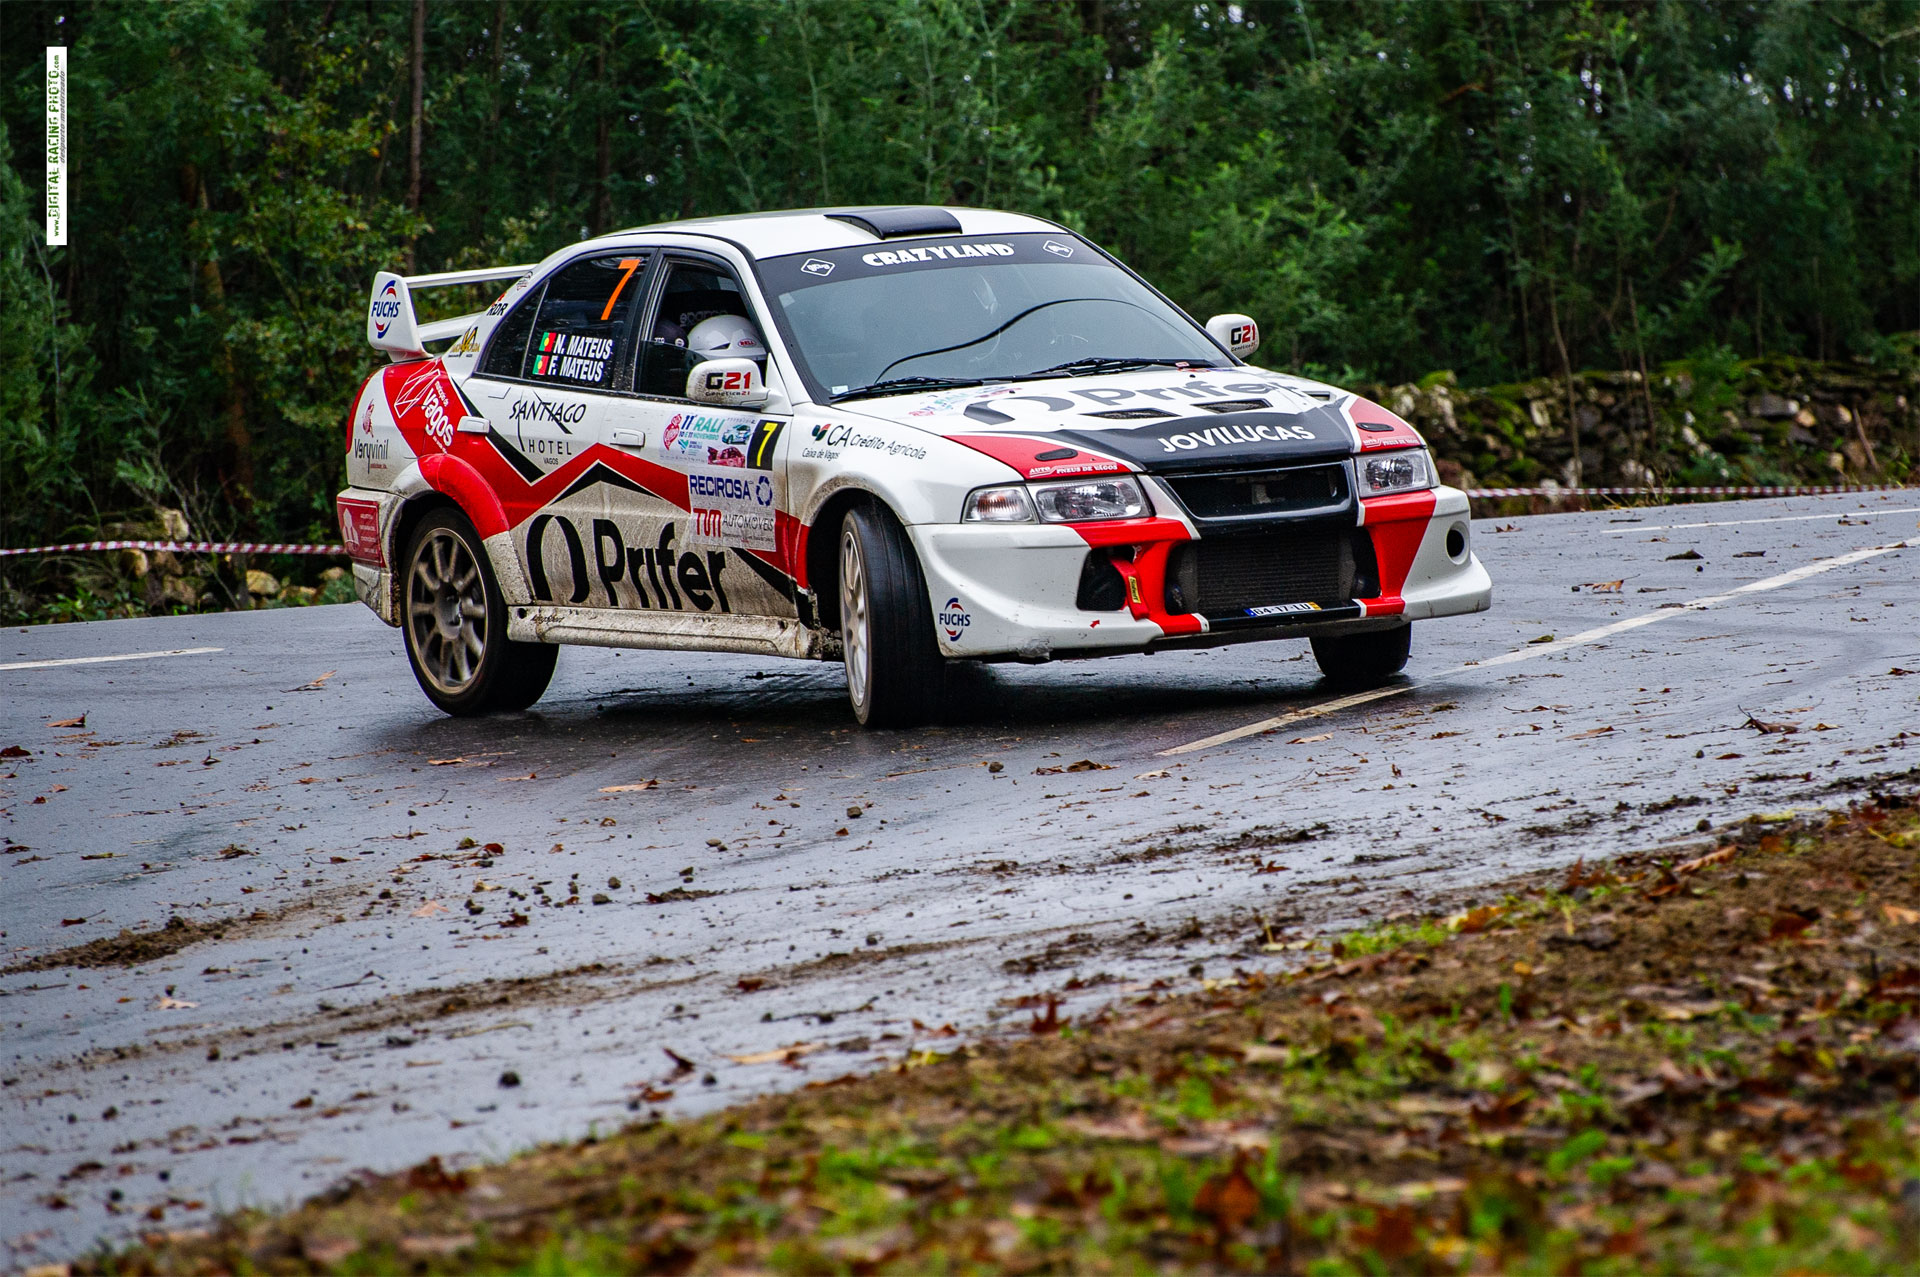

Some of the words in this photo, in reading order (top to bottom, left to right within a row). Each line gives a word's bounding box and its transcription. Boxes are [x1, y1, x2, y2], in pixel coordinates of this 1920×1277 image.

[862, 243, 1015, 267] CRAZYLAND
[600, 259, 641, 321] 7
[371, 301, 401, 318] FUCHS
[553, 333, 567, 355] N.
[566, 335, 613, 360] MATEUS
[1230, 323, 1256, 346] G21
[547, 355, 560, 376] F.
[559, 356, 604, 382] MATEUS
[705, 371, 752, 390] G21
[509, 400, 587, 425] SANTIAGO
[693, 417, 726, 433] RALI
[528, 439, 572, 456] HOTEL
[756, 422, 778, 467] 7
[827, 425, 853, 447] CA
[850, 434, 885, 450] Crédito
[884, 440, 927, 460] Agrícola
[1157, 425, 1316, 453] JOVILUCAS
[543, 457, 559, 466] VAGOS
[1028, 466, 1051, 474] AUTO
[689, 474, 752, 501] RECIROSA
[593, 518, 731, 613] Prifer
[939, 613, 971, 627] FUCHS
